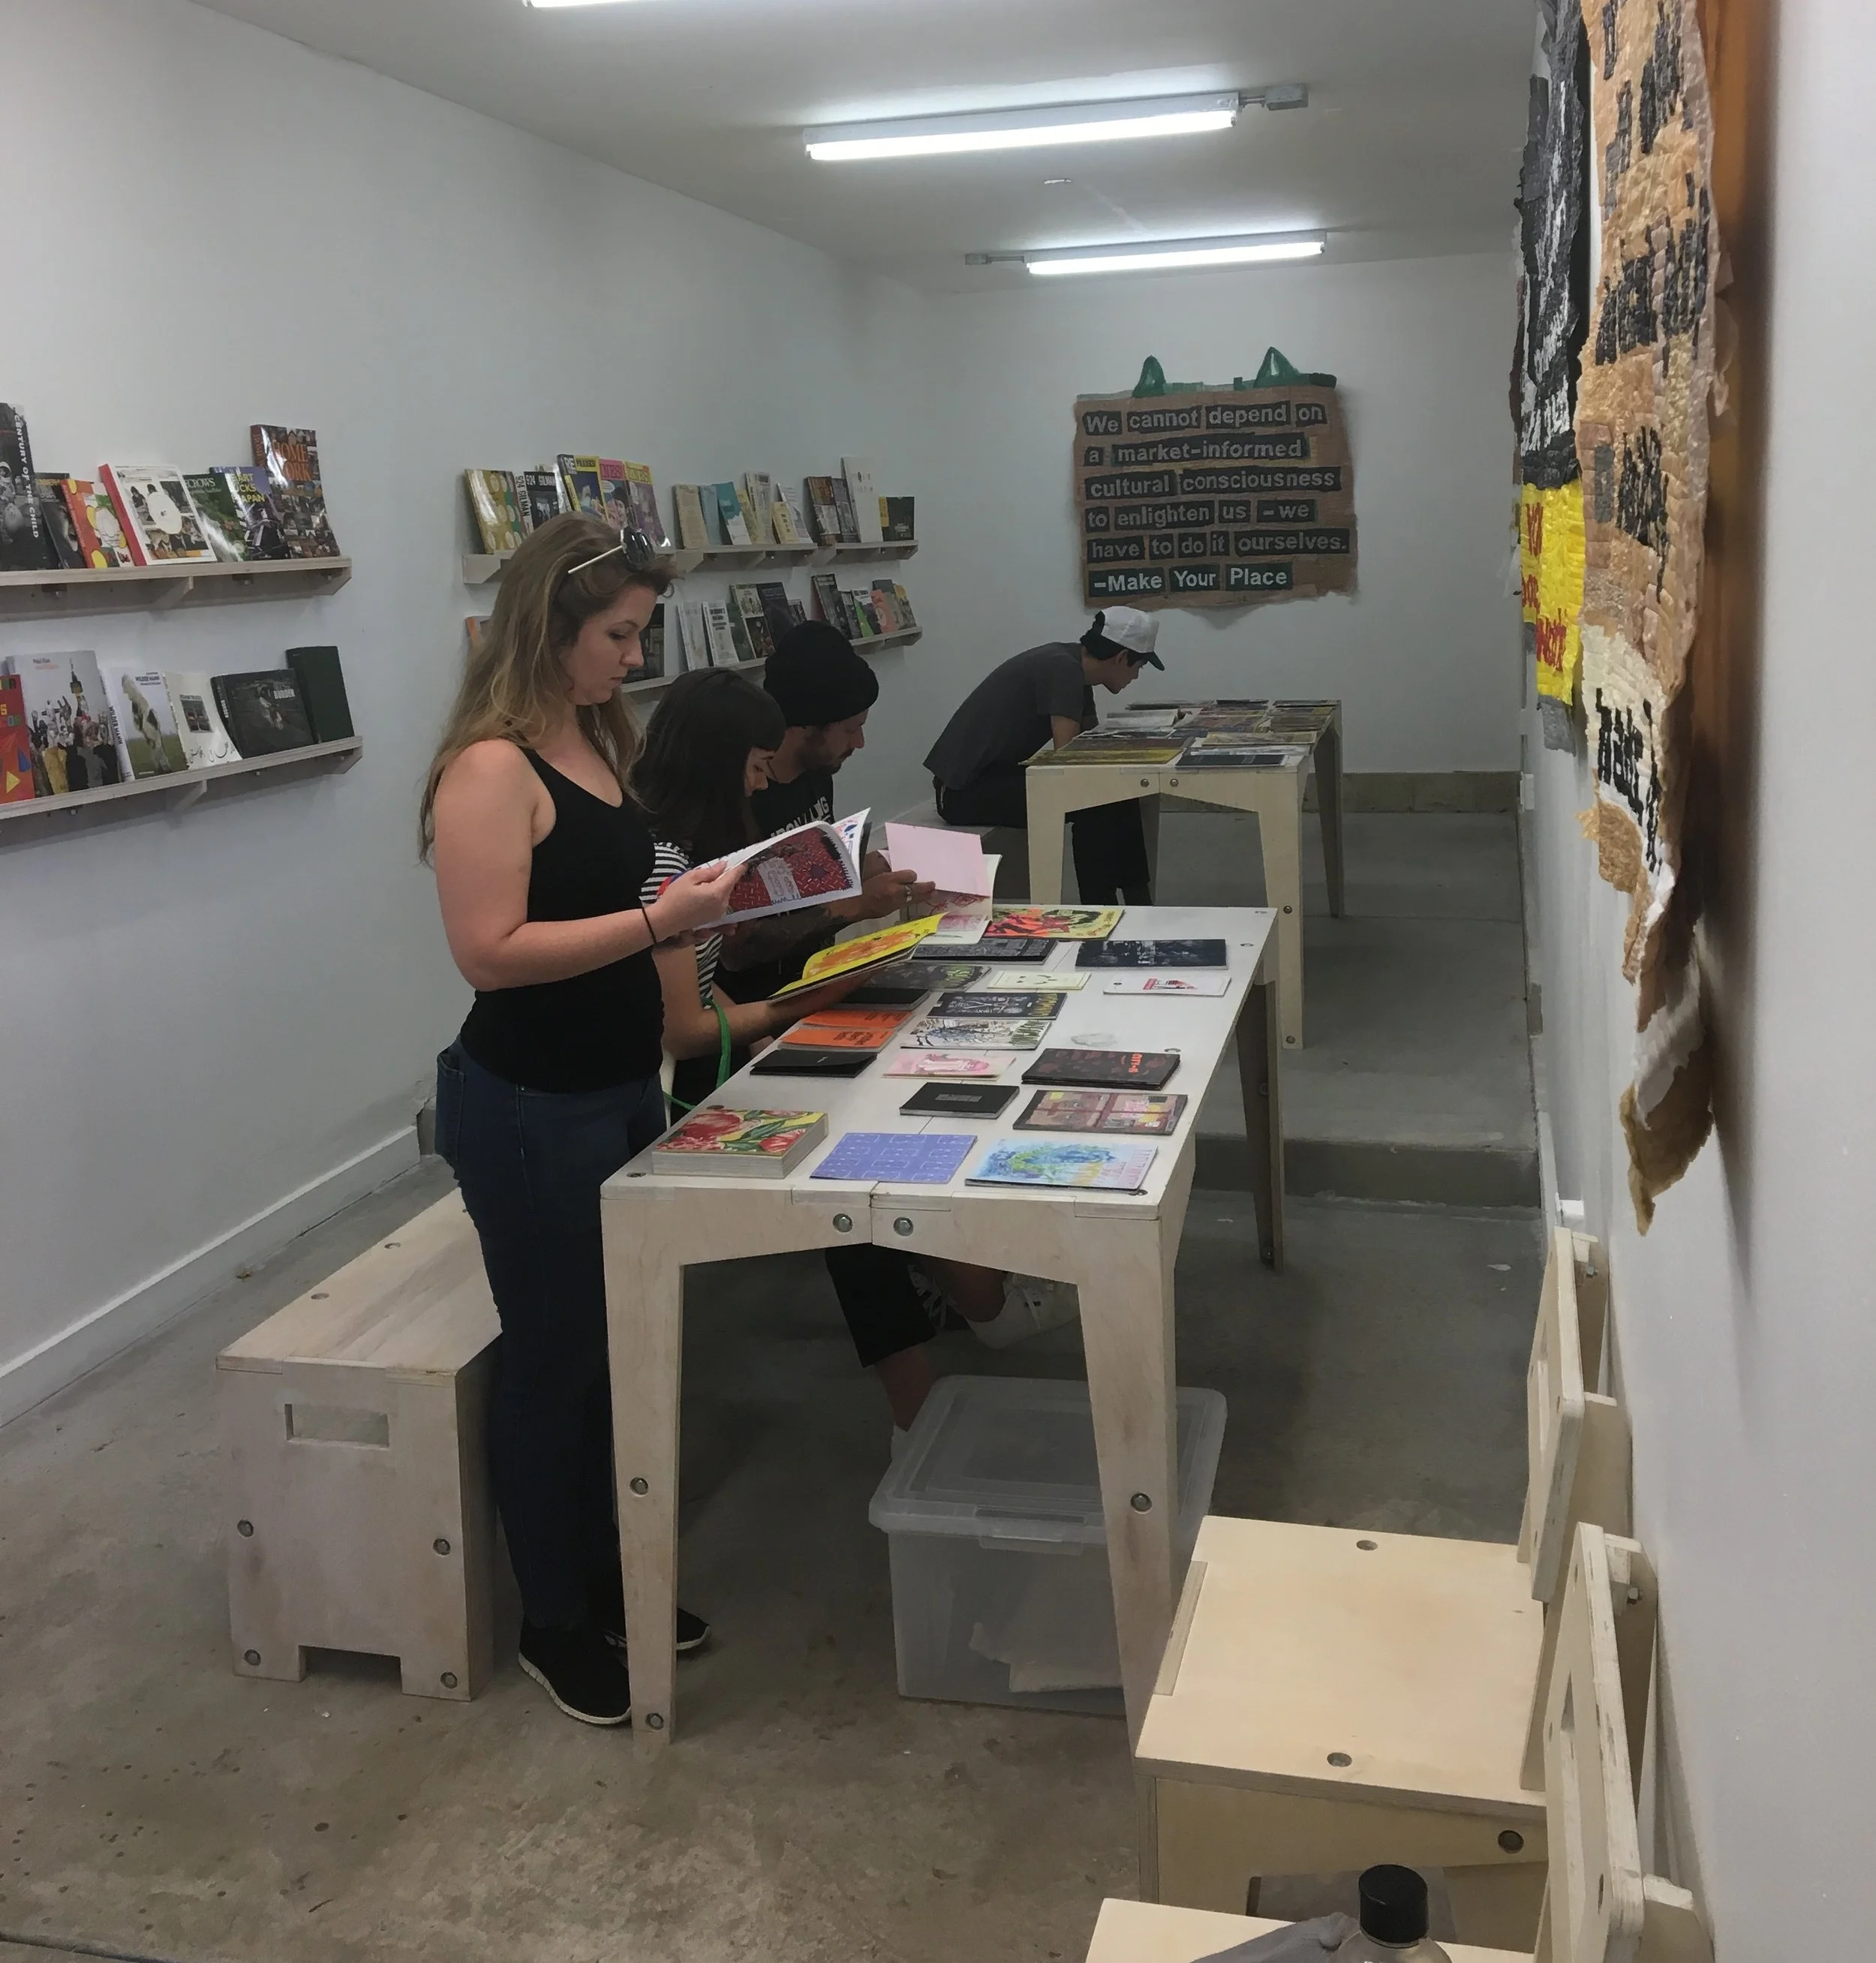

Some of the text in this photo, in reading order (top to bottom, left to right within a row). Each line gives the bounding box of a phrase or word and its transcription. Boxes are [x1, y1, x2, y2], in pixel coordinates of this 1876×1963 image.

[1085, 404, 1322, 434] We cannot depend on
[1089, 439, 1302, 463] a market-informed
[14, 414, 39, 538] CENTURY OF THE CHILD
[284, 462, 311, 481] ORK
[1090, 470, 1335, 498] cultural consciousness
[241, 494, 265, 503] APAN
[1088, 510, 1107, 529] to
[1117, 506, 1210, 529] enlighten
[1222, 505, 1247, 519] us
[1092, 532, 1347, 558] have to do it ourselves.
[1174, 570, 1216, 588] Your
[1230, 569, 1288, 586] Place
